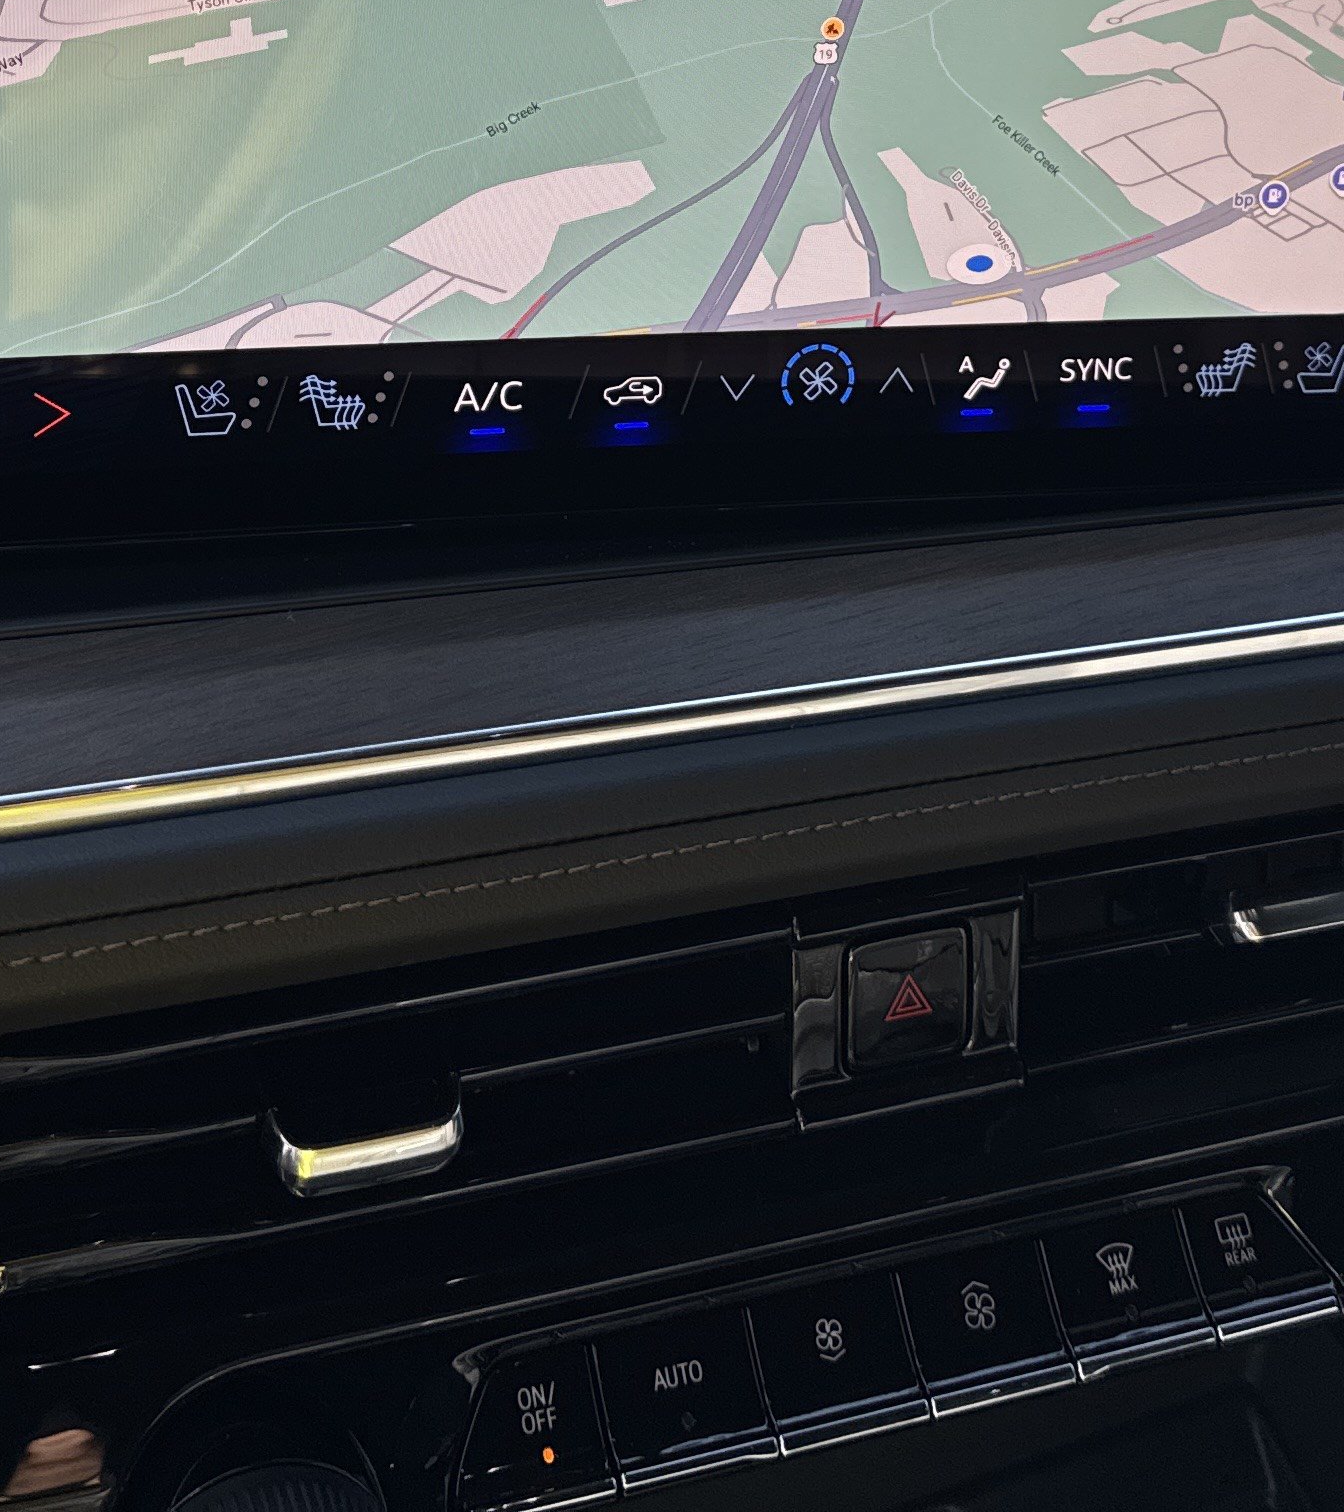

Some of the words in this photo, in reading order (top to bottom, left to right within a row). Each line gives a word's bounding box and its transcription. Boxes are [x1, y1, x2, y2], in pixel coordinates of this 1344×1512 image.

[819, 49, 833, 60] 19
[486, 118, 509, 138] Big
[507, 101, 542, 127] Creek
[992, 114, 1012, 136] Foe
[1009, 129, 1036, 154] Killer
[1033, 149, 1061, 178] Creek
[951, 170, 978, 202] Davis
[975, 196, 990, 212] Dr
[1233, 191, 1255, 210] bp
[987, 219, 1011, 251] Davis
[1059, 356, 1133, 383] SYNC
[454, 381, 524, 413] A/C
[1224, 1246, 1258, 1268] REAR
[1108, 1274, 1139, 1296] MAX
[654, 1359, 704, 1392] AUTO
[517, 1380, 555, 1411] ON/
[521, 1406, 557, 1435] OFF
